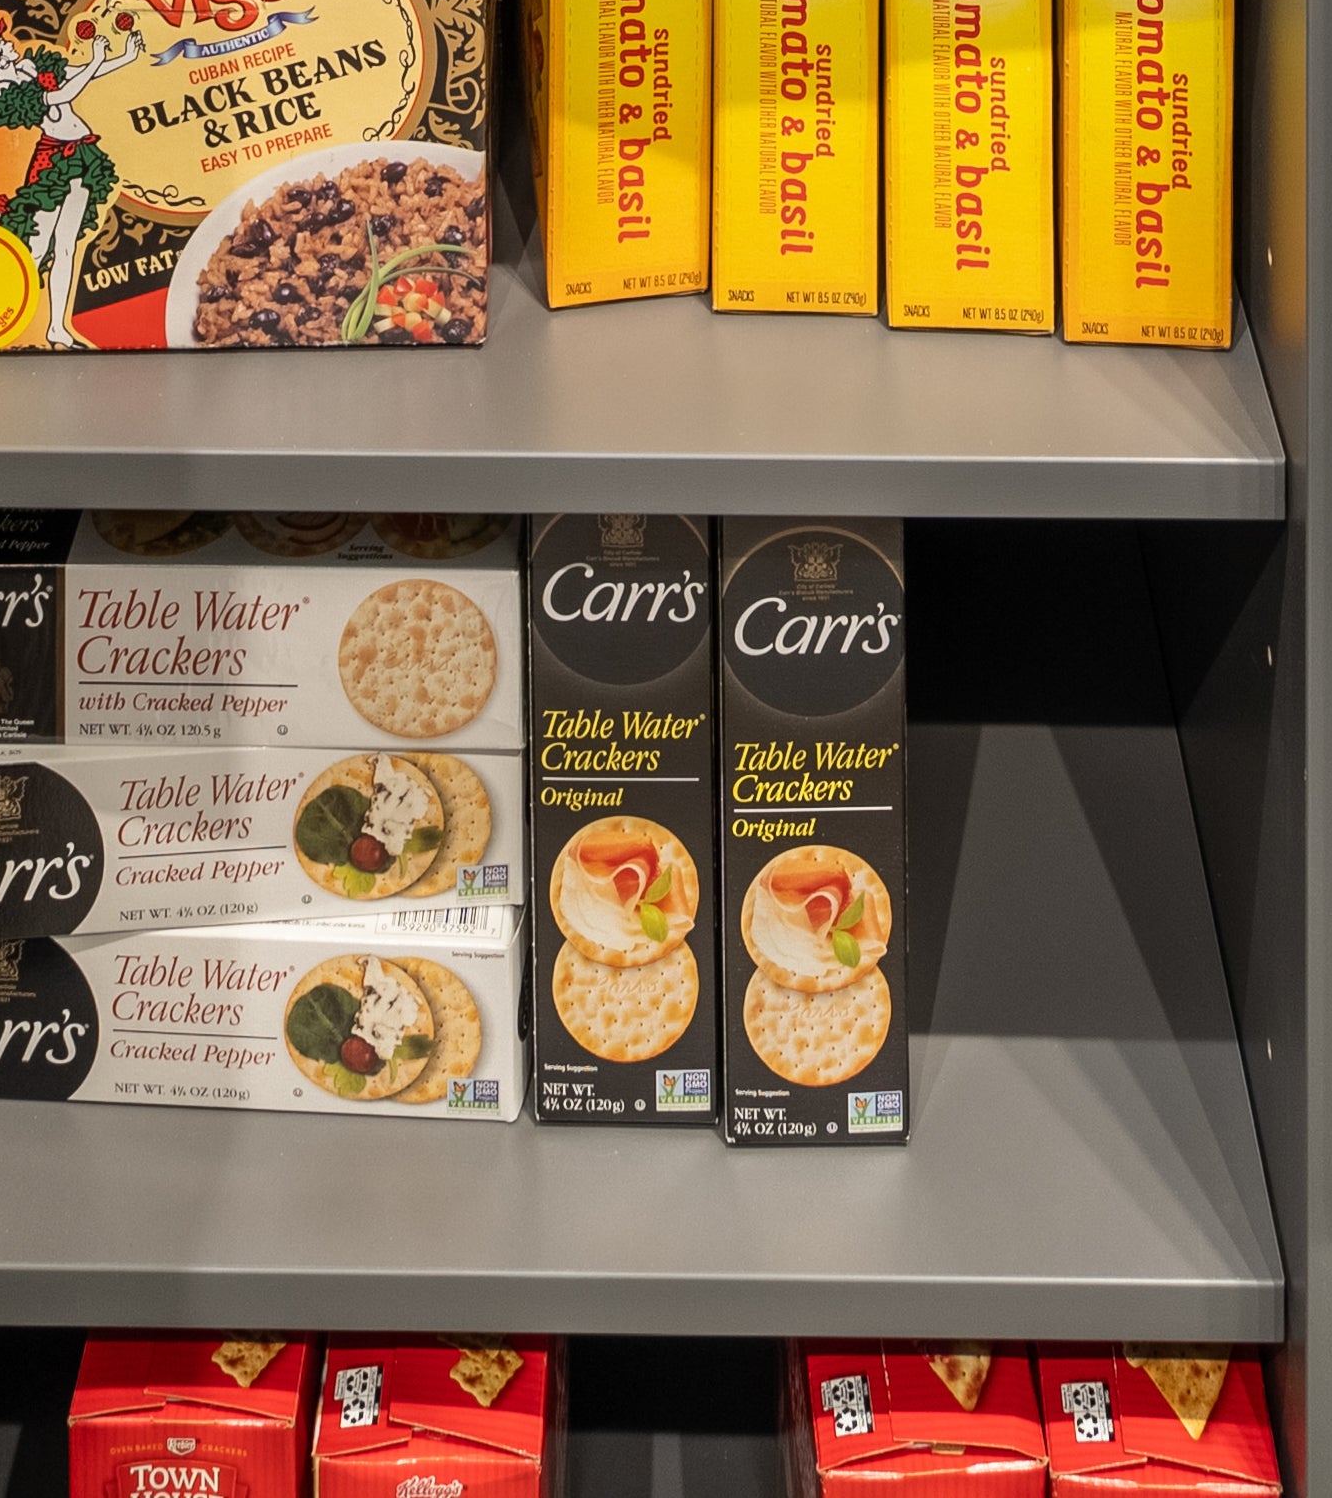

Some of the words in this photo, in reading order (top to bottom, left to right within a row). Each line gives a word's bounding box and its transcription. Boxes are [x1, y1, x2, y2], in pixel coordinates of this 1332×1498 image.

[129, 77, 252, 134] BLACK
[263, 39, 387, 92] BEANS
[203, 119, 231, 148] &
[236, 92, 322, 142] RICE
[619, 105, 643, 123] &
[618, 139, 651, 244] basil
[77, 588, 178, 631] Table
[193, 589, 301, 632] Water
[543, 563, 705, 622] Carr's
[734, 597, 897, 655] Carr's
[76, 636, 246, 677] Crackers
[543, 710, 614, 739] Table
[622, 711, 700, 740] Water
[541, 743, 661, 771] Crackers
[734, 741, 807, 771] Table
[815, 742, 893, 771] Water
[119, 778, 200, 811] Table
[210, 772, 298, 803] Water
[732, 773, 853, 803] Crackers
[117, 810, 253, 848] Crackers
[113, 954, 193, 989] Table
[201, 960, 287, 994] Water
[111, 991, 245, 1026] Crackers
[130, 1465, 220, 1492] TOWN
